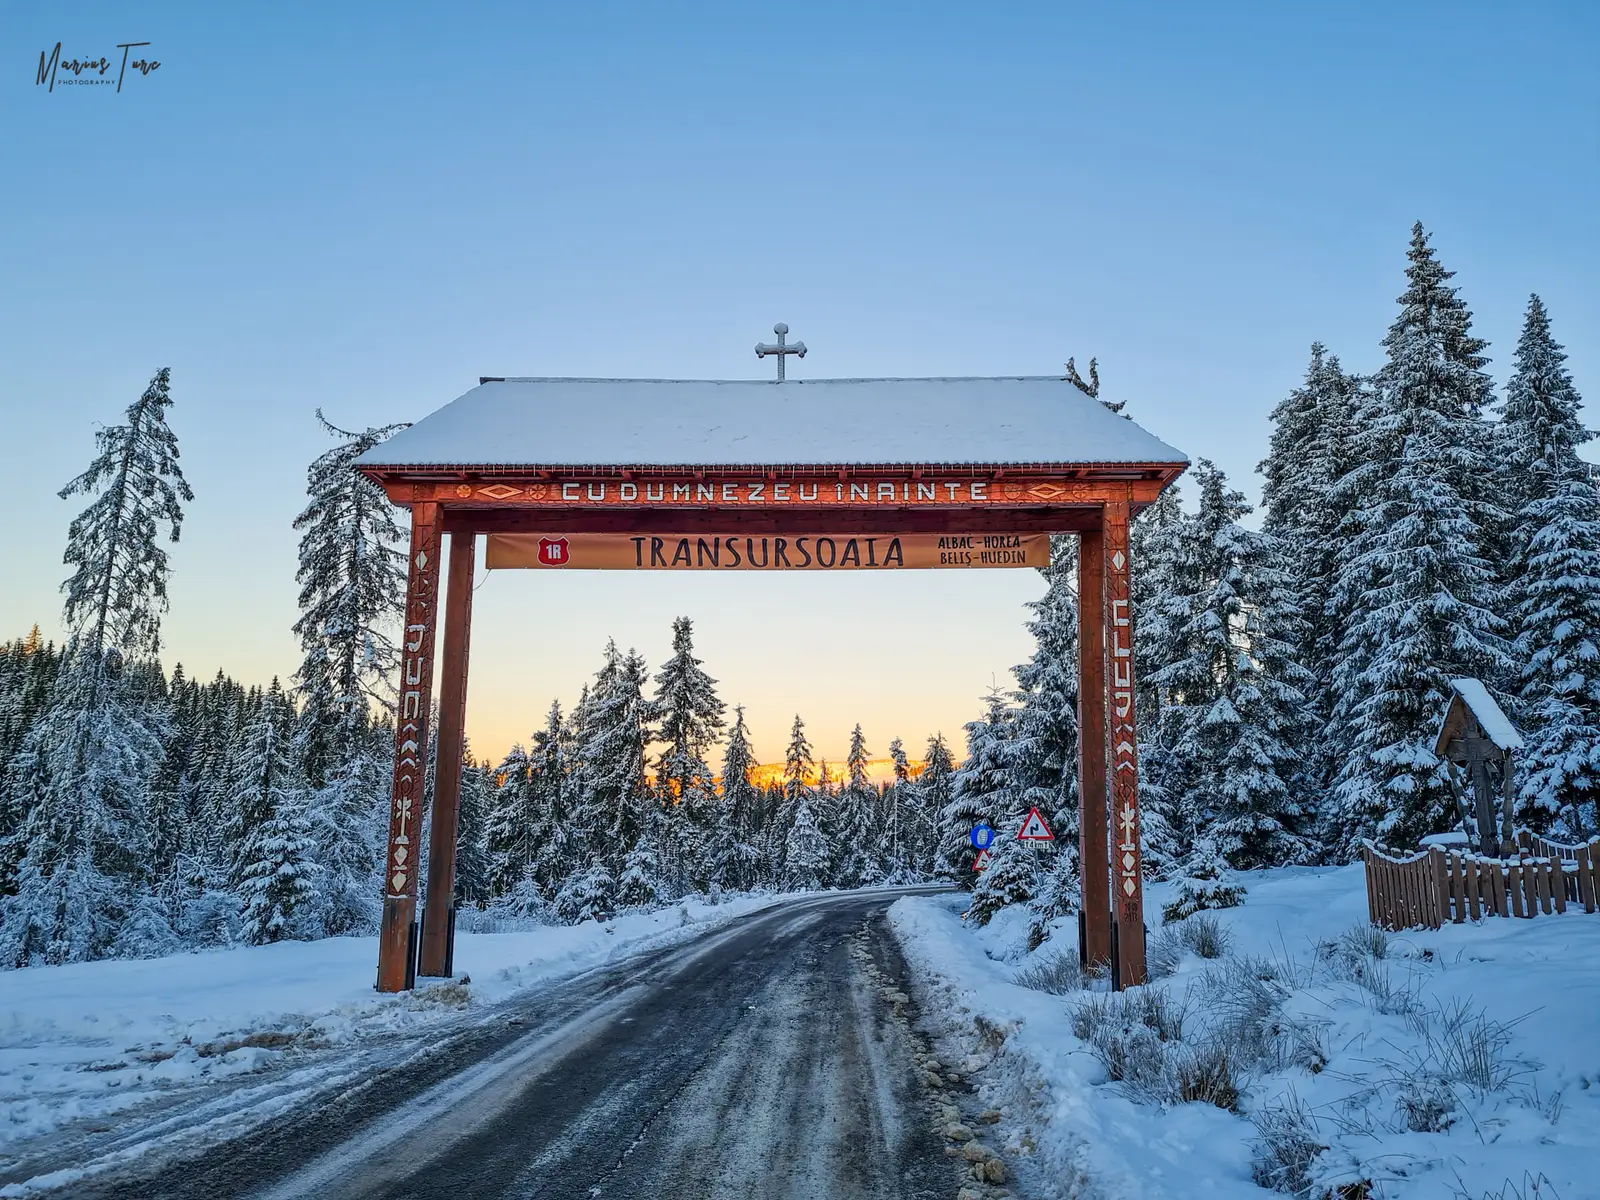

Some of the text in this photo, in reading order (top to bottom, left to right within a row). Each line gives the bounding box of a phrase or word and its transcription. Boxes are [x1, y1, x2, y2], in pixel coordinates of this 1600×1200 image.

[562, 482, 605, 500] CU
[620, 483, 818, 501] DUMNEZEU
[545, 544, 561, 560] 1R
[629, 536, 904, 568] TRANSURSOAIA
